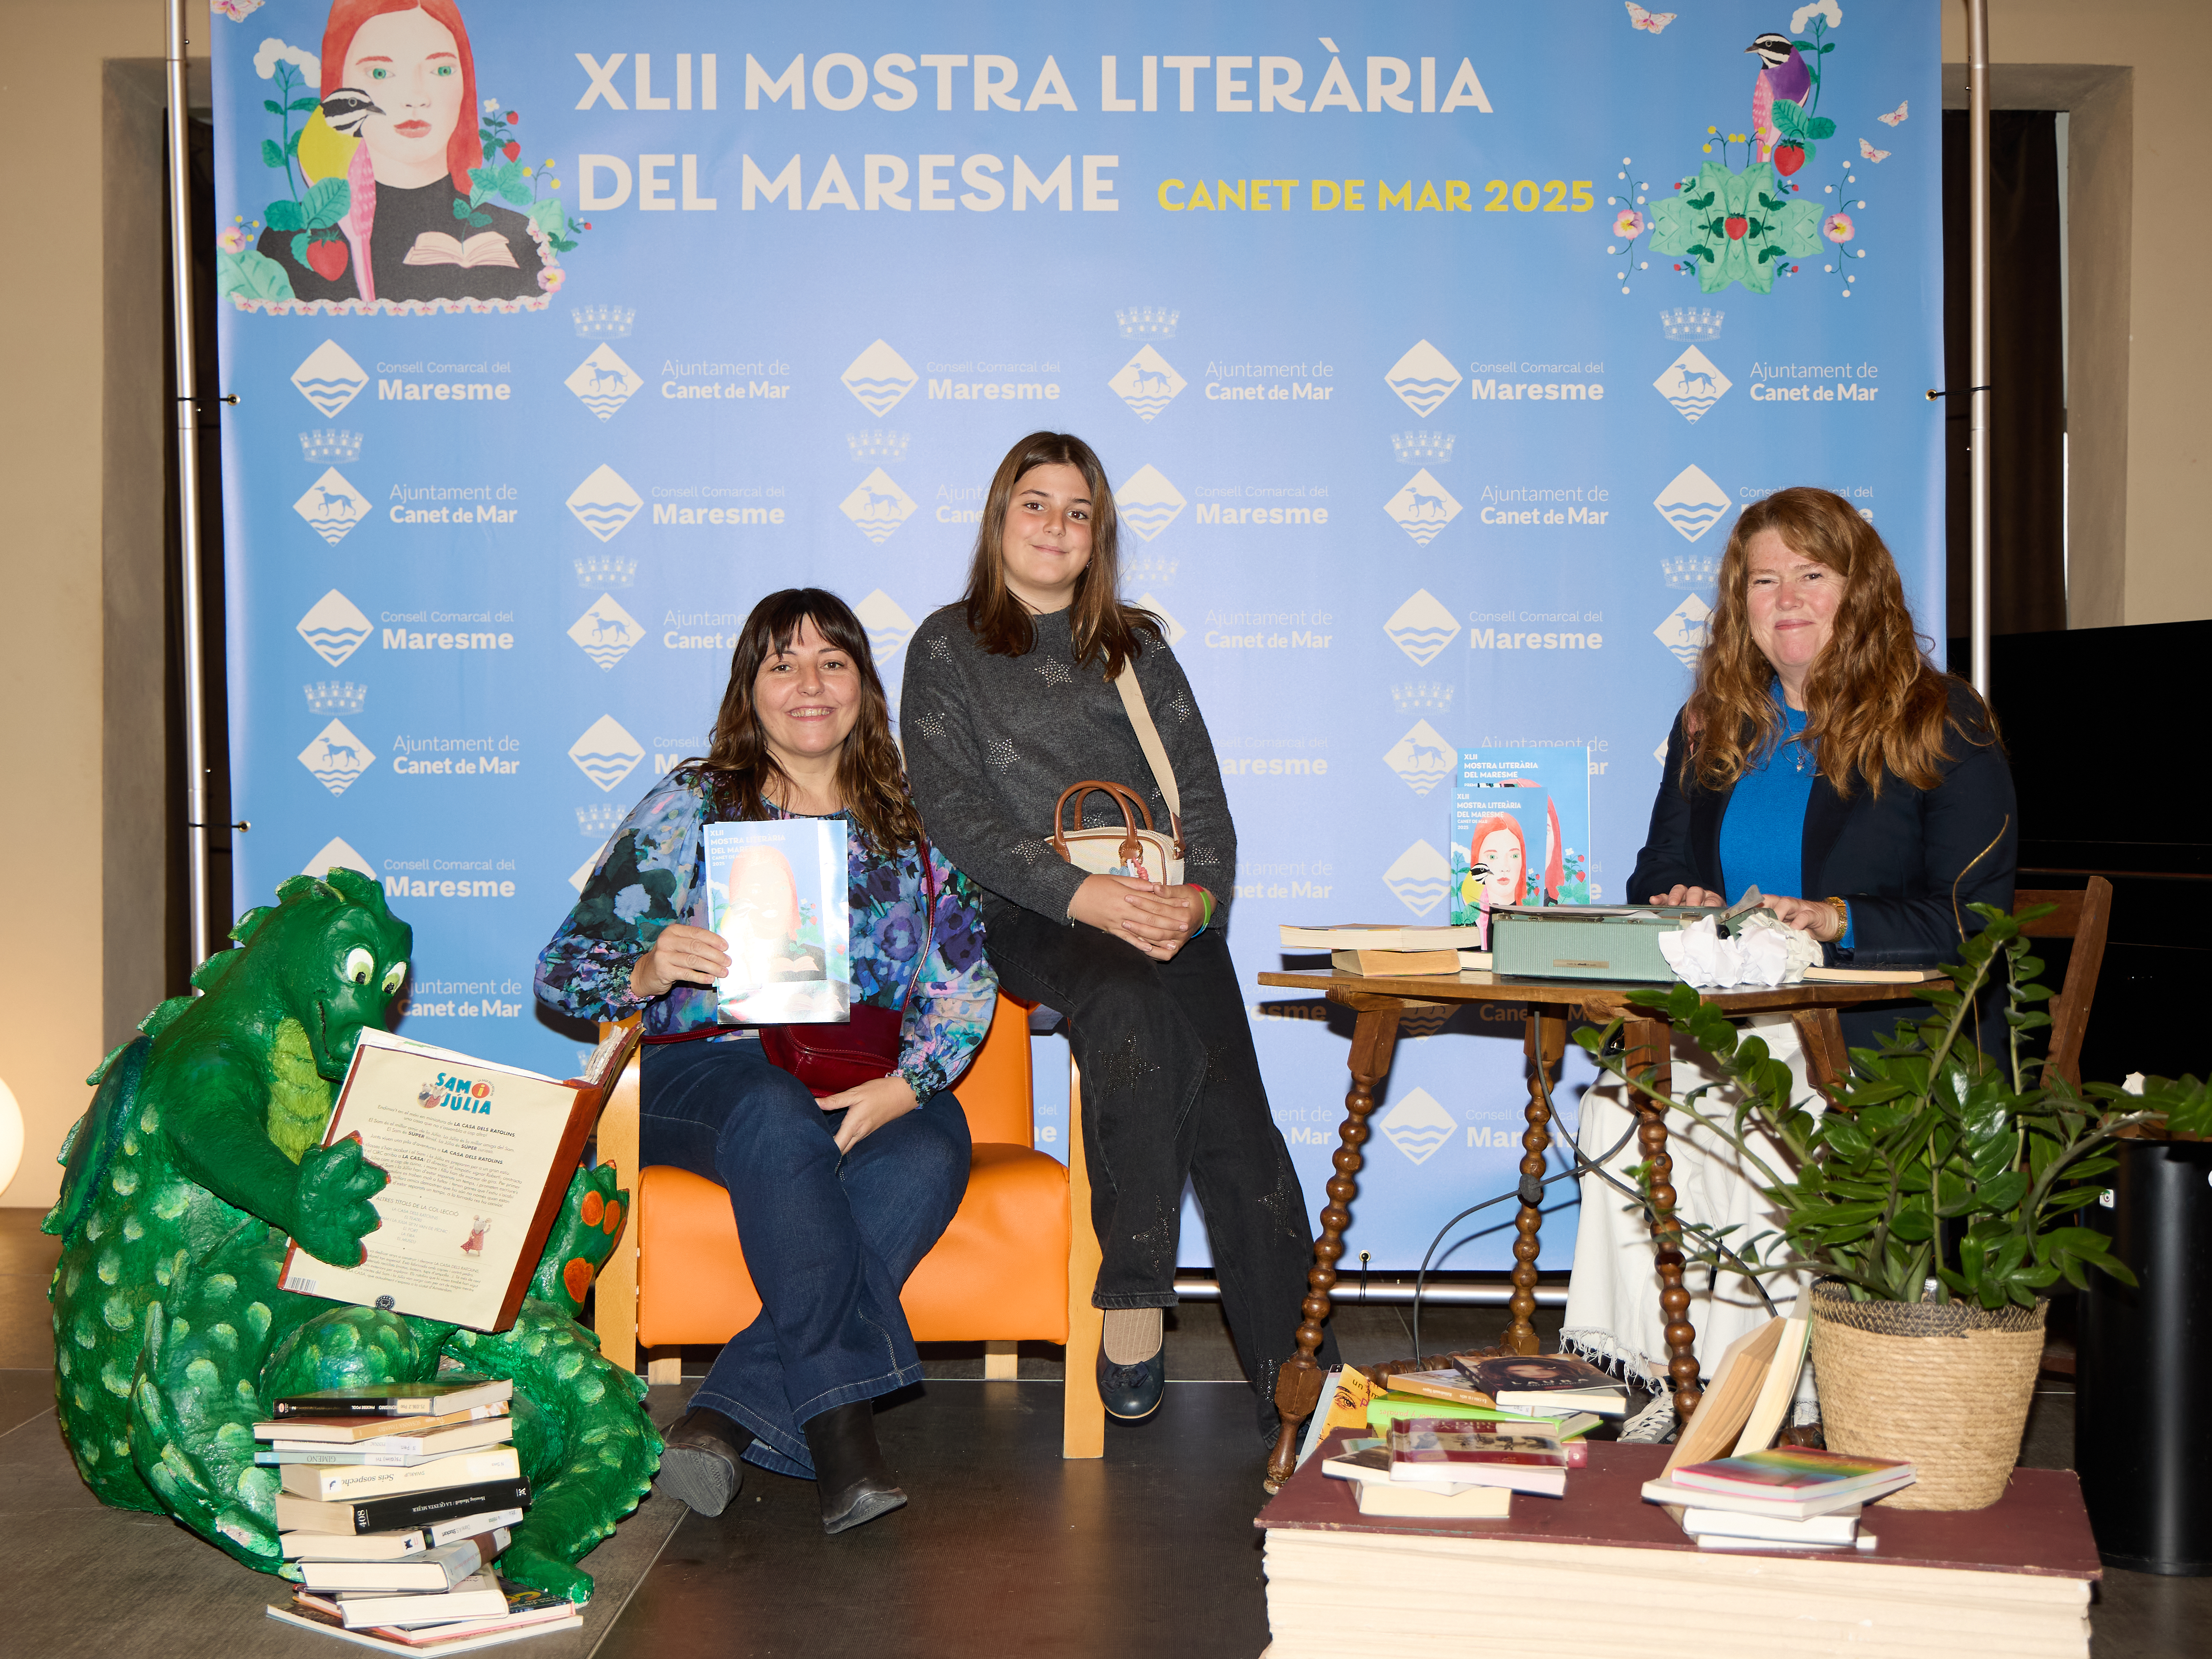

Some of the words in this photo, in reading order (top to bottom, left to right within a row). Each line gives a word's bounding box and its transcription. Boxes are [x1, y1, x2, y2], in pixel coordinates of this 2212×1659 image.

[575, 53, 717, 110] XLII
[745, 52, 1078, 112] MOSTRA
[1101, 37, 1493, 114] LITERÀRIA
[578, 154, 717, 211] DEL
[742, 153, 1119, 212] MARESME
[1158, 179, 1299, 211] CANET
[1311, 179, 1365, 211] DE
[1378, 180, 1472, 212] MAR
[1484, 180, 1594, 212] 2025
[376, 361, 424, 373] Consell
[427, 361, 489, 373] Comarcal
[491, 361, 512, 374] del
[662, 360, 764, 379] Ajuntament
[768, 359, 790, 376] de
[926, 361, 974, 373] Consell
[977, 361, 1038, 373] Comarcal
[1041, 361, 1061, 373] del
[1205, 361, 1308, 380] Ajuntament
[1312, 361, 1333, 377] de
[1470, 361, 1517, 373] Consell
[1520, 361, 1582, 373] Comarcal
[1585, 361, 1604, 373] del
[1750, 361, 1852, 381] Ajuntament
[1856, 361, 1878, 378] de
[378, 379, 511, 401] Maresme
[662, 381, 721, 399] Canet
[724, 383, 746, 399] de
[749, 381, 790, 399] Mar
[928, 378, 1060, 400] Maresme
[1205, 382, 1265, 400] Canet
[1268, 384, 1289, 400] de
[1292, 382, 1333, 400] Mar
[1472, 379, 1604, 400] Maresme
[1750, 382, 1810, 401] Canet
[1813, 385, 1834, 401] de
[1837, 383, 1879, 401] Mar
[389, 483, 492, 504] Ajuntament
[496, 483, 518, 500] de
[651, 486, 699, 498] Consell
[701, 485, 763, 498] Comarcal
[765, 485, 785, 498] del
[1195, 485, 1242, 498] Consell
[1245, 486, 1306, 497] Comarcal
[1309, 486, 1329, 497] del
[1480, 485, 1583, 505] Ajuntament
[1587, 485, 1609, 502] de
[1854, 486, 1873, 498] del
[389, 505, 450, 523] Canet
[452, 507, 474, 523] de
[476, 505, 518, 523] Mar
[653, 503, 785, 525] Maresme
[936, 505, 984, 523] Cane
[1196, 503, 1328, 524] Maresme
[1480, 506, 1541, 525] Canet
[1543, 509, 1564, 525] de
[1568, 506, 1609, 525] Mar
[381, 610, 427, 622] Consell
[431, 610, 492, 623] Comarcal
[494, 610, 514, 623] del
[663, 610, 749, 629] Ajuntame
[1204, 609, 1307, 628] Ajuntament
[1311, 609, 1333, 626] de
[1469, 610, 1516, 622] Consell
[1519, 611, 1580, 622] Comarcal
[1584, 611, 1603, 622] del
[382, 628, 514, 650] Maresme
[663, 631, 723, 649] Canet
[1204, 630, 1264, 649] Canet
[1267, 633, 1288, 648] de
[1291, 630, 1333, 649] Mar
[1470, 628, 1603, 649] Maresme
[393, 735, 495, 755] Ajuntament
[498, 735, 520, 752] de
[653, 736, 699, 748] Consell
[1245, 736, 1305, 748] Comarcal
[1309, 736, 1329, 748] del
[1588, 736, 1608, 752] de
[393, 756, 453, 774] Canet
[455, 758, 476, 774] de
[479, 756, 520, 774] Mar
[746, 834, 785, 843] LITERÀRIA
[383, 858, 430, 870] Consell
[433, 858, 493, 871] Comarcal
[496, 858, 516, 871] del
[1311, 860, 1333, 876] de
[385, 876, 516, 897] Maresme
[1267, 883, 1289, 899] de
[1291, 881, 1333, 899] Mar
[501, 978, 522, 995] de
[397, 998, 456, 1017] Canet
[458, 1001, 479, 1017] de
[482, 999, 523, 1017] Mar
[435, 1072, 472, 1094] SAM
[440, 1093, 491, 1115] JÚLIA
[1038, 1104, 1058, 1115] del
[1311, 1105, 1333, 1122] de
[1466, 1109, 1512, 1120] Consell
[1291, 1126, 1333, 1145] Mar
[1353, 1379, 1363, 1390] un
[1380, 1409, 1408, 1418] pañales
[378, 1474, 394, 1482] Seis
[357, 1509, 367, 1528] 408
